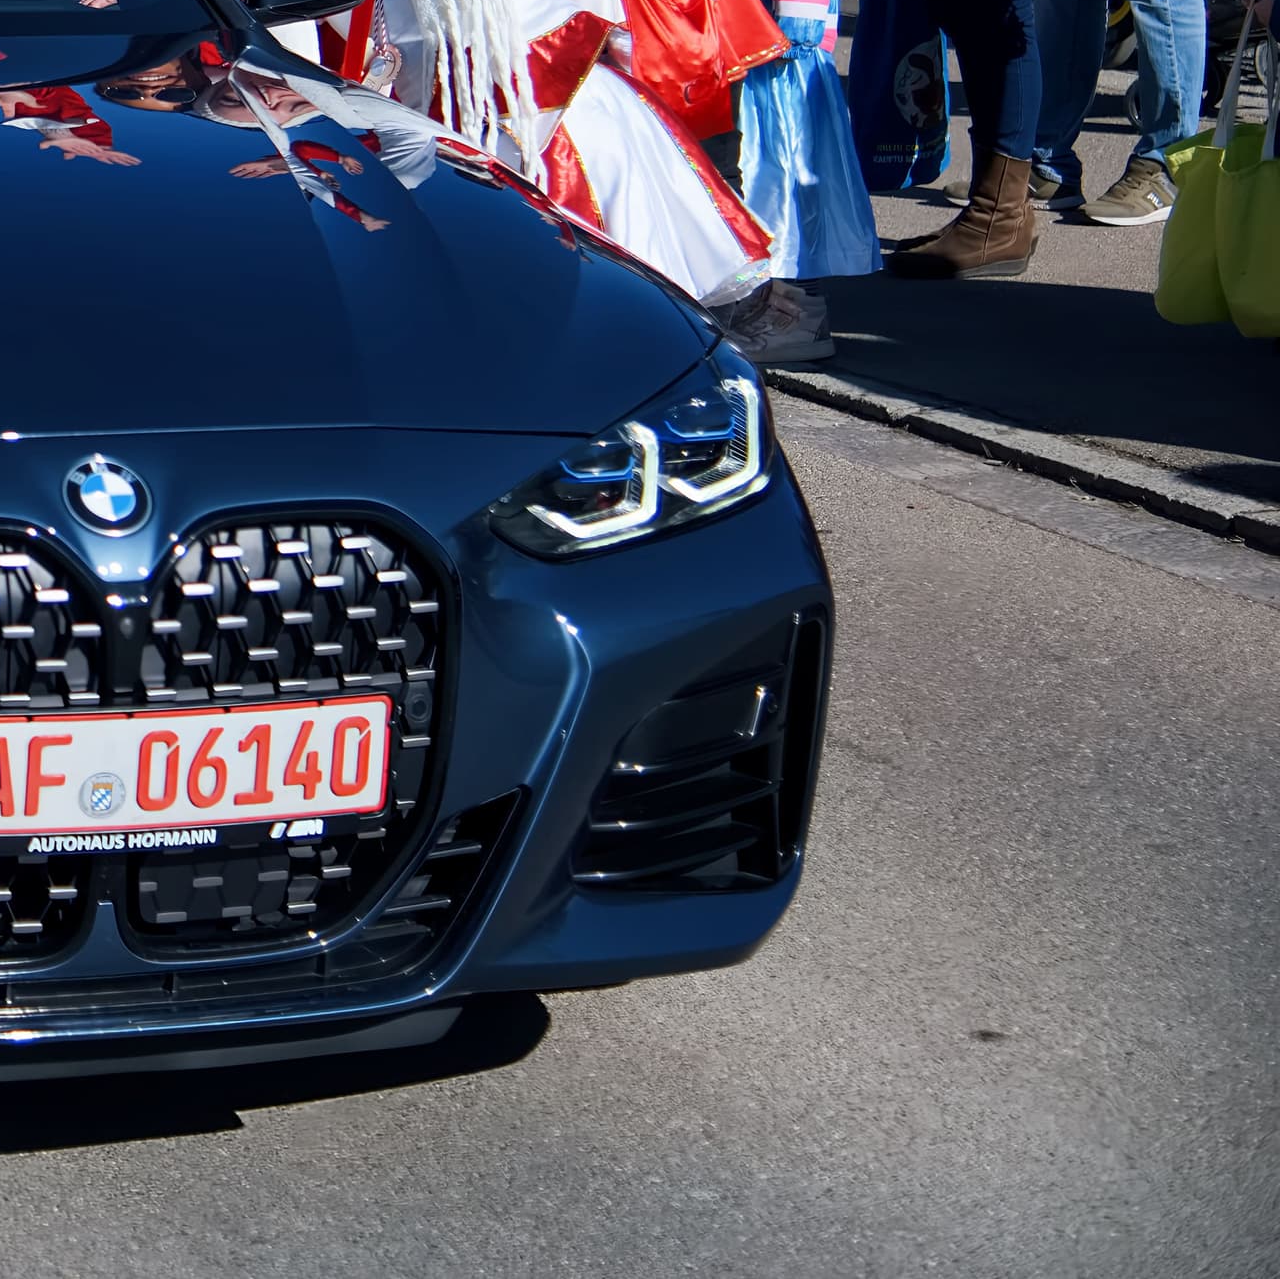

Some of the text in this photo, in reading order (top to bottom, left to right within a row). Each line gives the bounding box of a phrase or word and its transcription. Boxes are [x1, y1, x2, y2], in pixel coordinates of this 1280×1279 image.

[136, 715, 372, 812] 06140
[27, 828, 217, 853] AUTOHAUS HOFMANN
